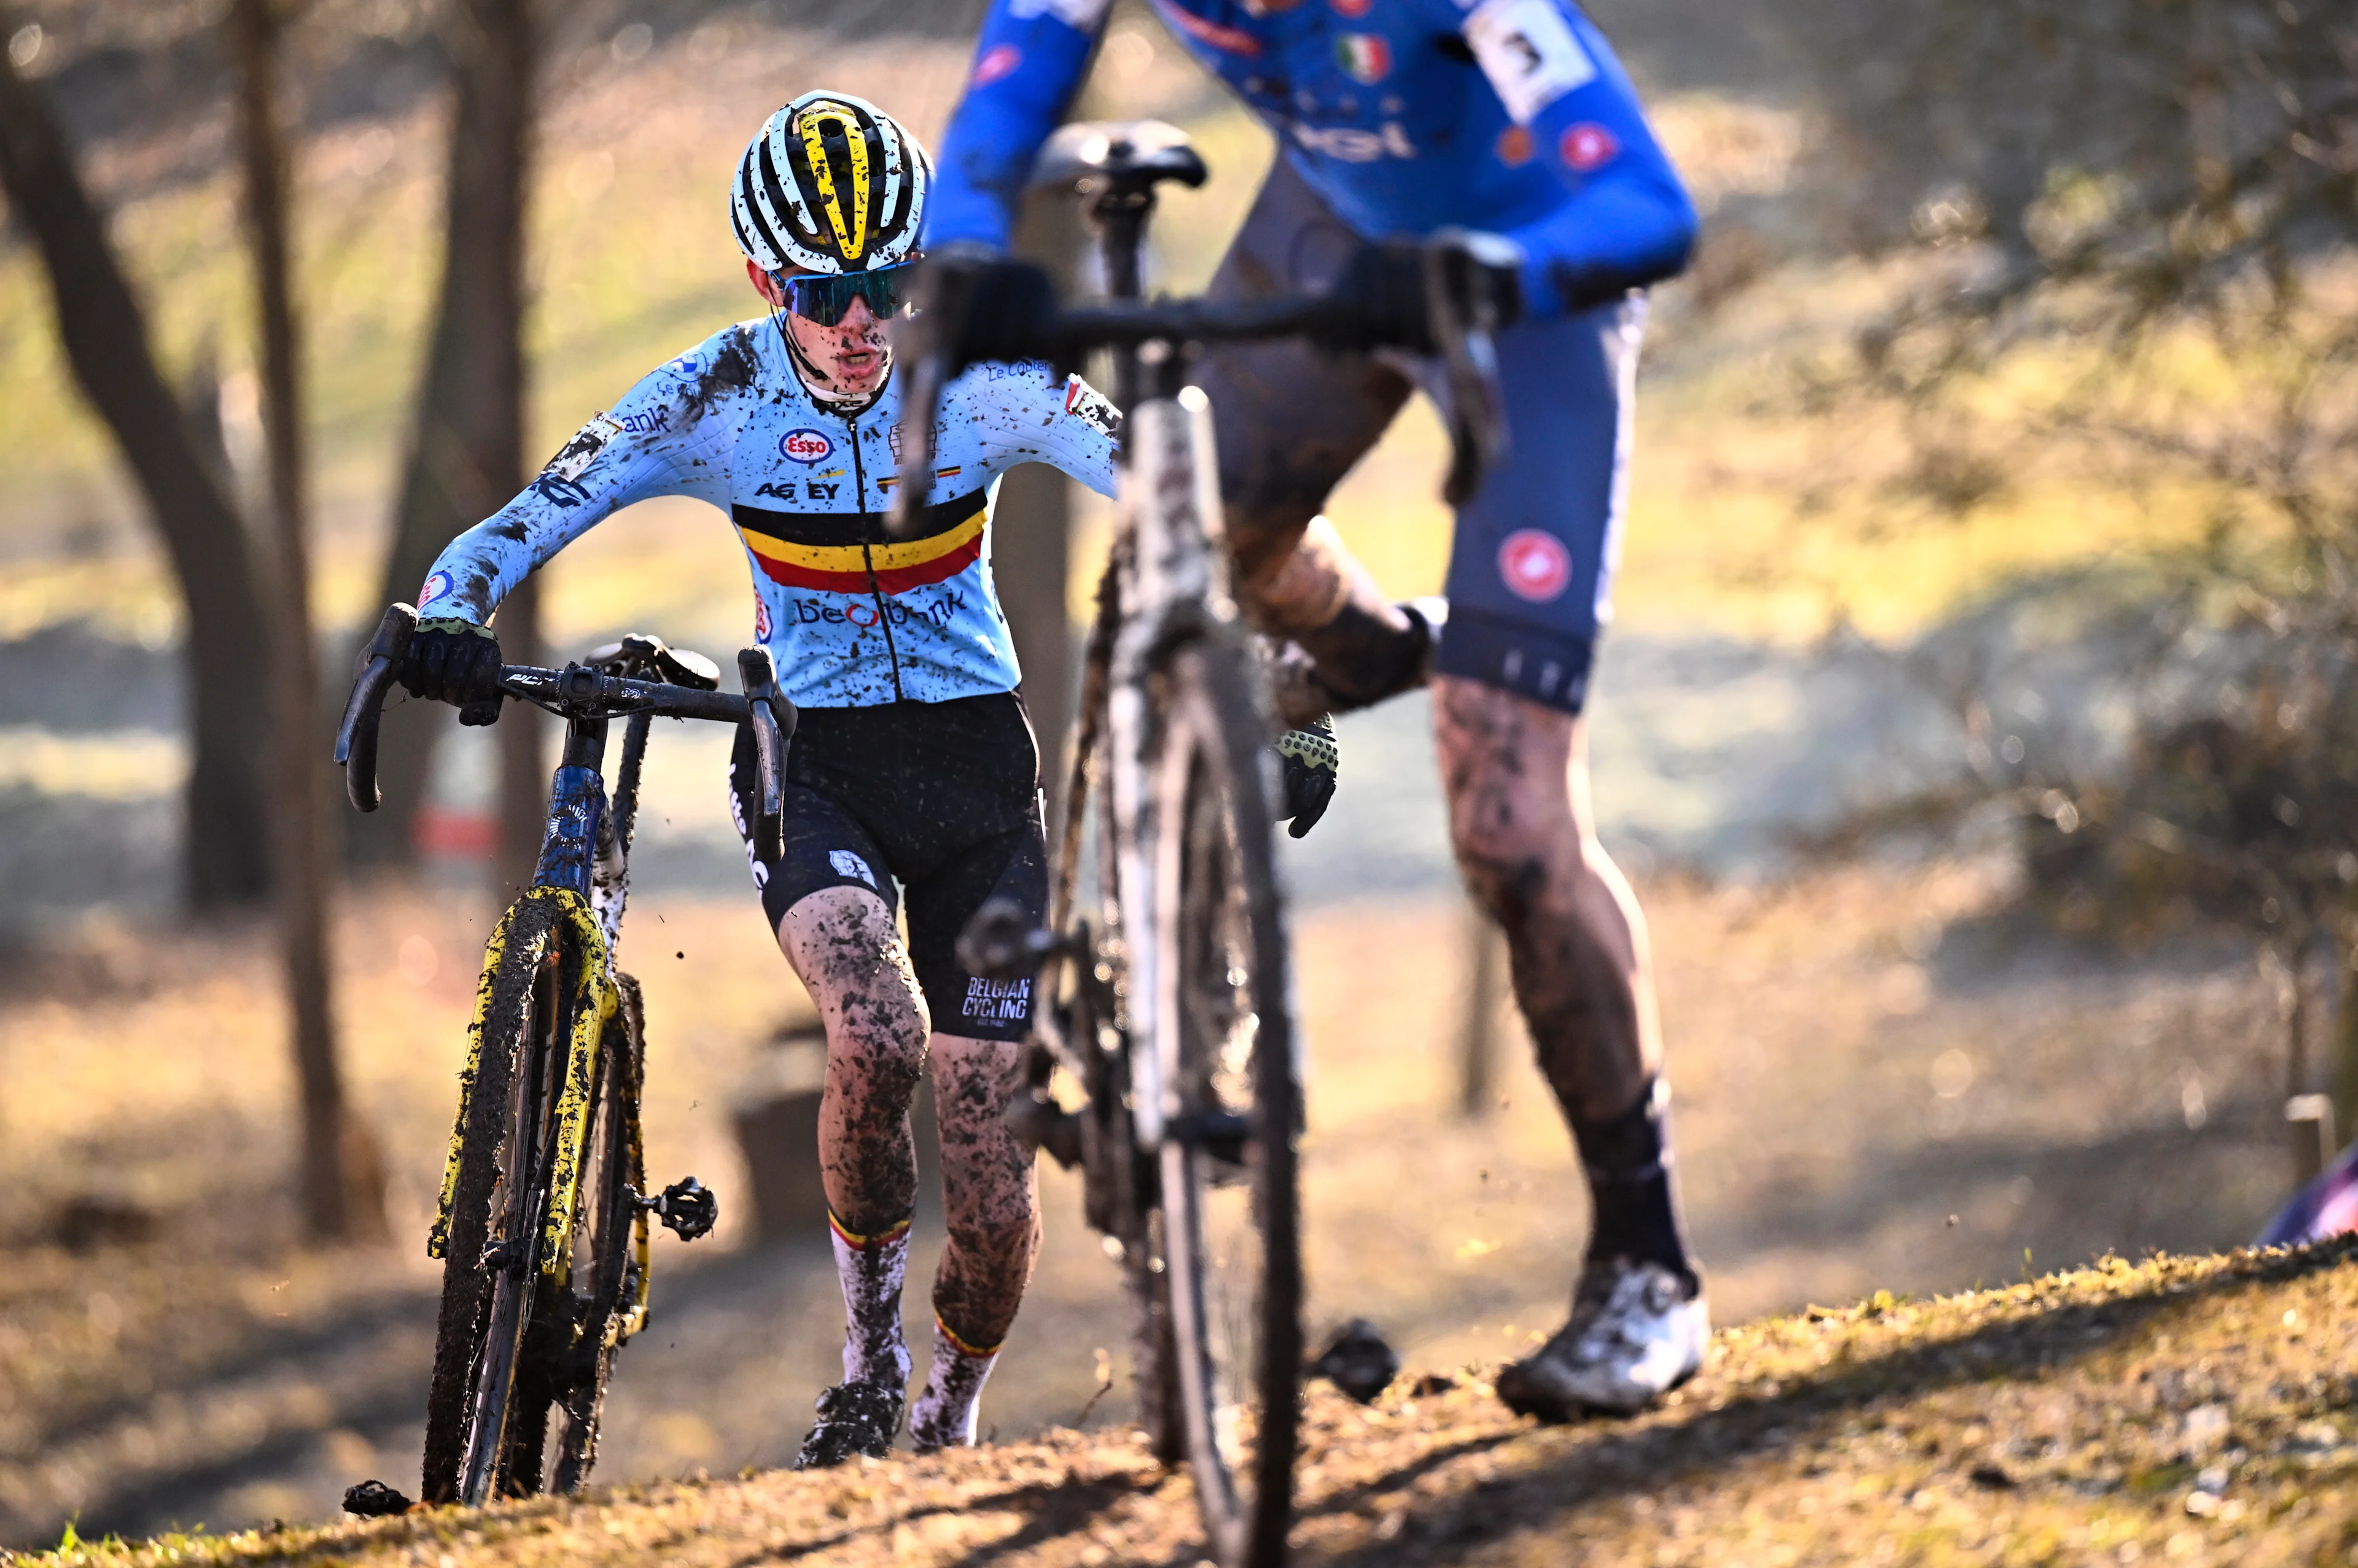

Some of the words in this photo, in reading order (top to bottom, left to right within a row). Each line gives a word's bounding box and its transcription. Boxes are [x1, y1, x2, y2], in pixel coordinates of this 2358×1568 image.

[788, 437, 826, 453] Esso
[807, 483, 840, 499] EY
[967, 977, 1030, 999] BELGIAN
